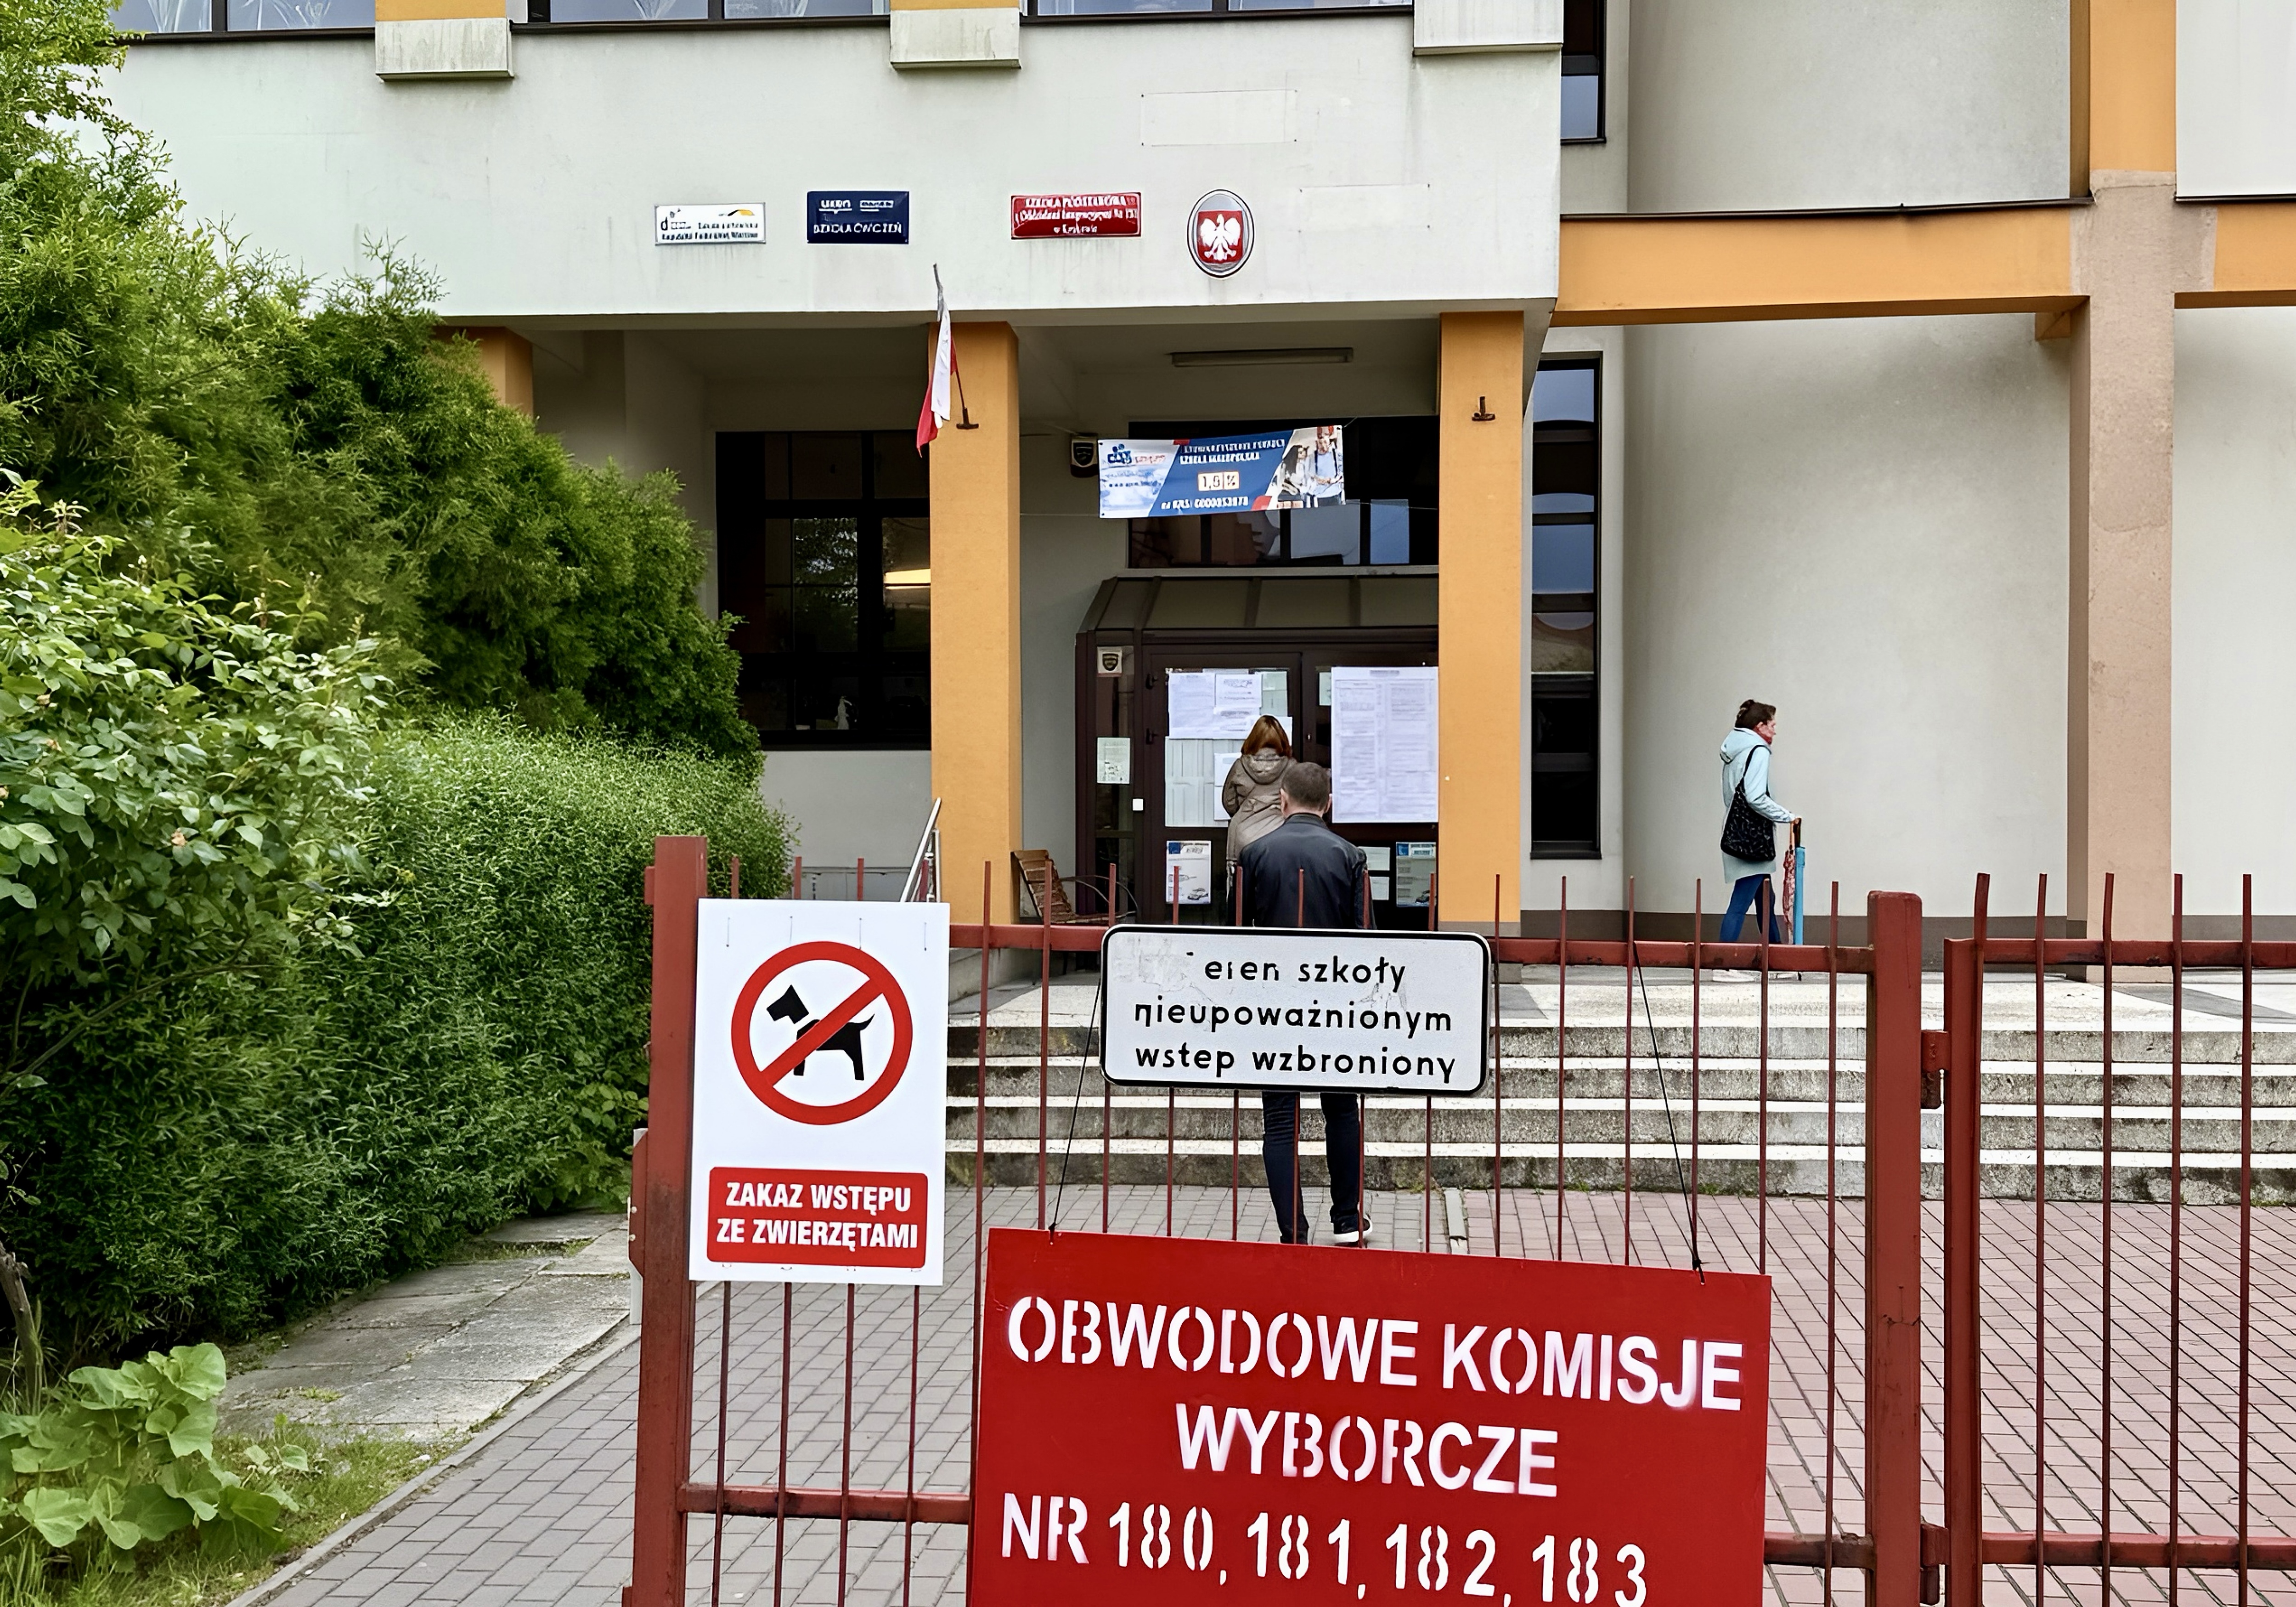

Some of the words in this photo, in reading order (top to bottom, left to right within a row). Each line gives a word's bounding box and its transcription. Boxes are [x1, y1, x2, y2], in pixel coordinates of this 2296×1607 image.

[1186, 951, 1280, 981] eren
[1297, 955, 1406, 993] szkoły
[1134, 994, 1451, 1040] nieupoważnionym
[1252, 1044, 1455, 1084] wzbroniony
[726, 1182, 804, 1208] ZAKAZ
[810, 1184, 911, 1217] WSTĘPU
[716, 1217, 745, 1244] ZE
[751, 1218, 918, 1252] ZWIERZĘTAMI
[1007, 1296, 1420, 1387] OBWODOWE
[1442, 1323, 1744, 1412] KOMISJE
[1175, 1403, 1559, 1498] WYBORCZE
[1001, 1492, 1089, 1565] NR
[1108, 1501, 1229, 1587] 180,
[1247, 1512, 1366, 1600] 181,
[1532, 1534, 1647, 1607] 183
